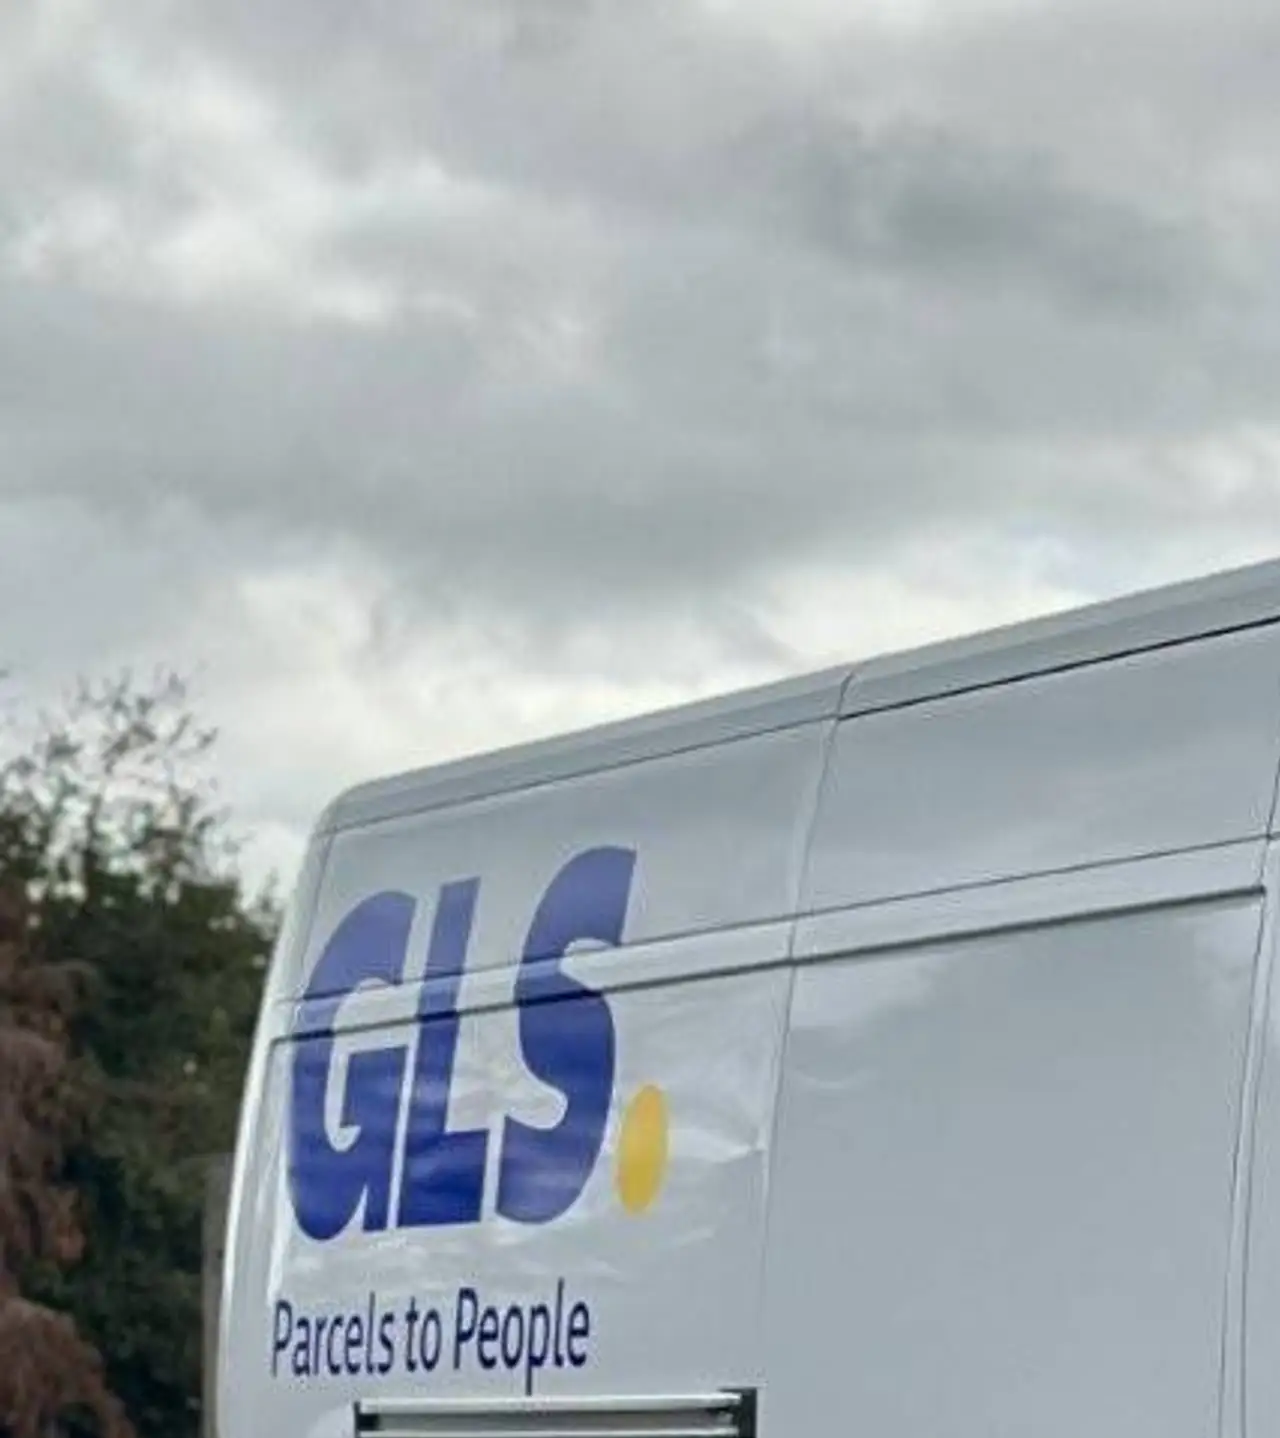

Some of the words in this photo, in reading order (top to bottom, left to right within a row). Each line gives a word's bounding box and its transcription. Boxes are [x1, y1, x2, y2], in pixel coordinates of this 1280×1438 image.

[271, 1291, 395, 1378] Parcels
[405, 1296, 442, 1370] to
[452, 1278, 591, 1395] People
